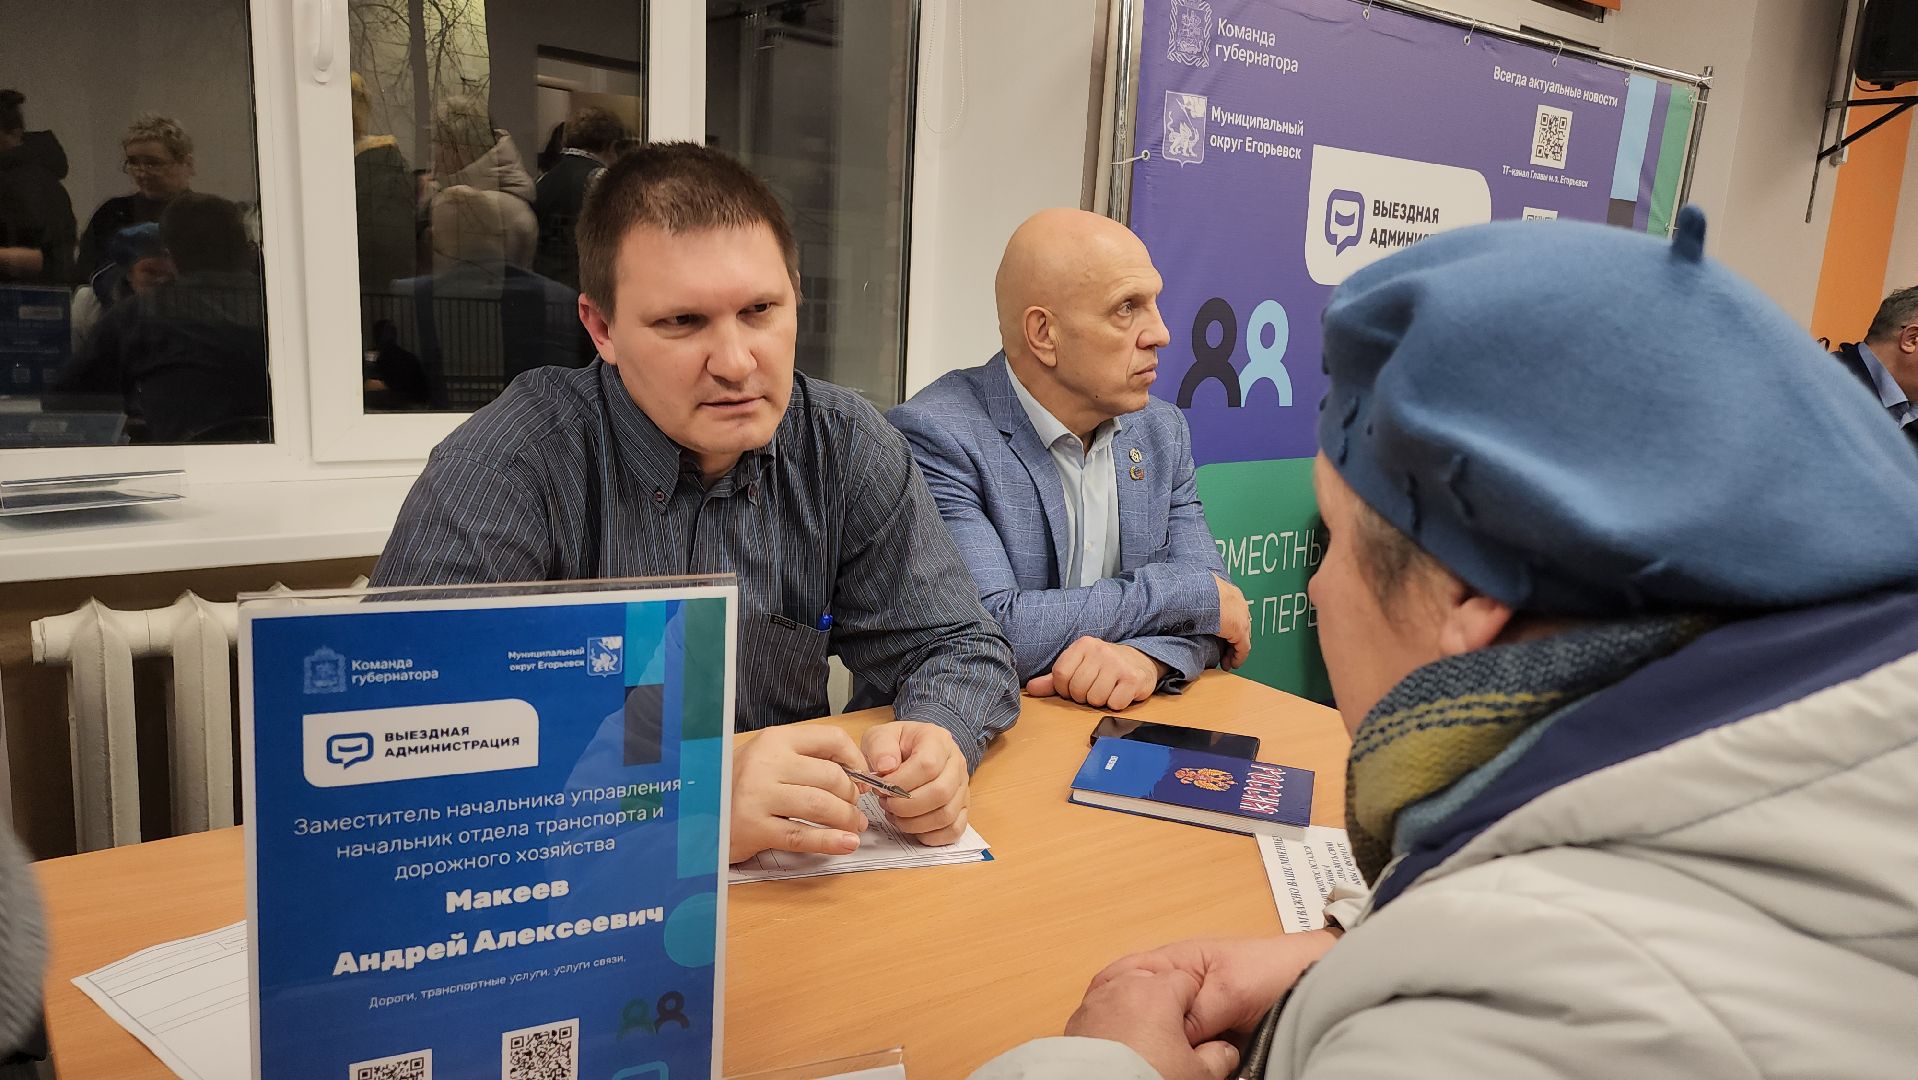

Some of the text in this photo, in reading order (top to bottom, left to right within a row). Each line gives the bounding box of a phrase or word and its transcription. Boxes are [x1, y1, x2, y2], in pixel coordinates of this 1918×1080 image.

[1217, 18, 1276, 47] Команда
[1215, 44, 1299, 75] губернатора
[1493, 66, 1618, 107] Всегда актуальные новости
[1211, 105, 1304, 137] Муниципальный
[1209, 134, 1302, 160] округ Егорьевск
[1530, 170, 1548, 181] Главы
[1560, 175, 1588, 188] Егорьевск
[1372, 199, 1440, 225] ВЫЕЗДНАЯ
[351, 658, 413, 671] Команда
[508, 646, 585, 660] Муниципальный
[509, 658, 585, 673] округ Егорьевск
[351, 668, 439, 687] губернатора
[384, 726, 471, 743] ВЫЕЗДНАЯ
[384, 736, 521, 759] АДМИНИСТРАЦИЯ
[294, 803, 441, 837] Заместитель
[446, 790, 566, 819] начальника
[570, 776, 682, 808] управления
[336, 806, 665, 861] начальник отдела транспорта и
[394, 836, 616, 882] дорожного хозяйства
[445, 878, 570, 914] Макеев
[332, 906, 665, 976] Андрей Алексеевич
[369, 992, 418, 1010] Дороги,
[421, 975, 507, 1000] транспортные
[553, 960, 591, 977] услуги
